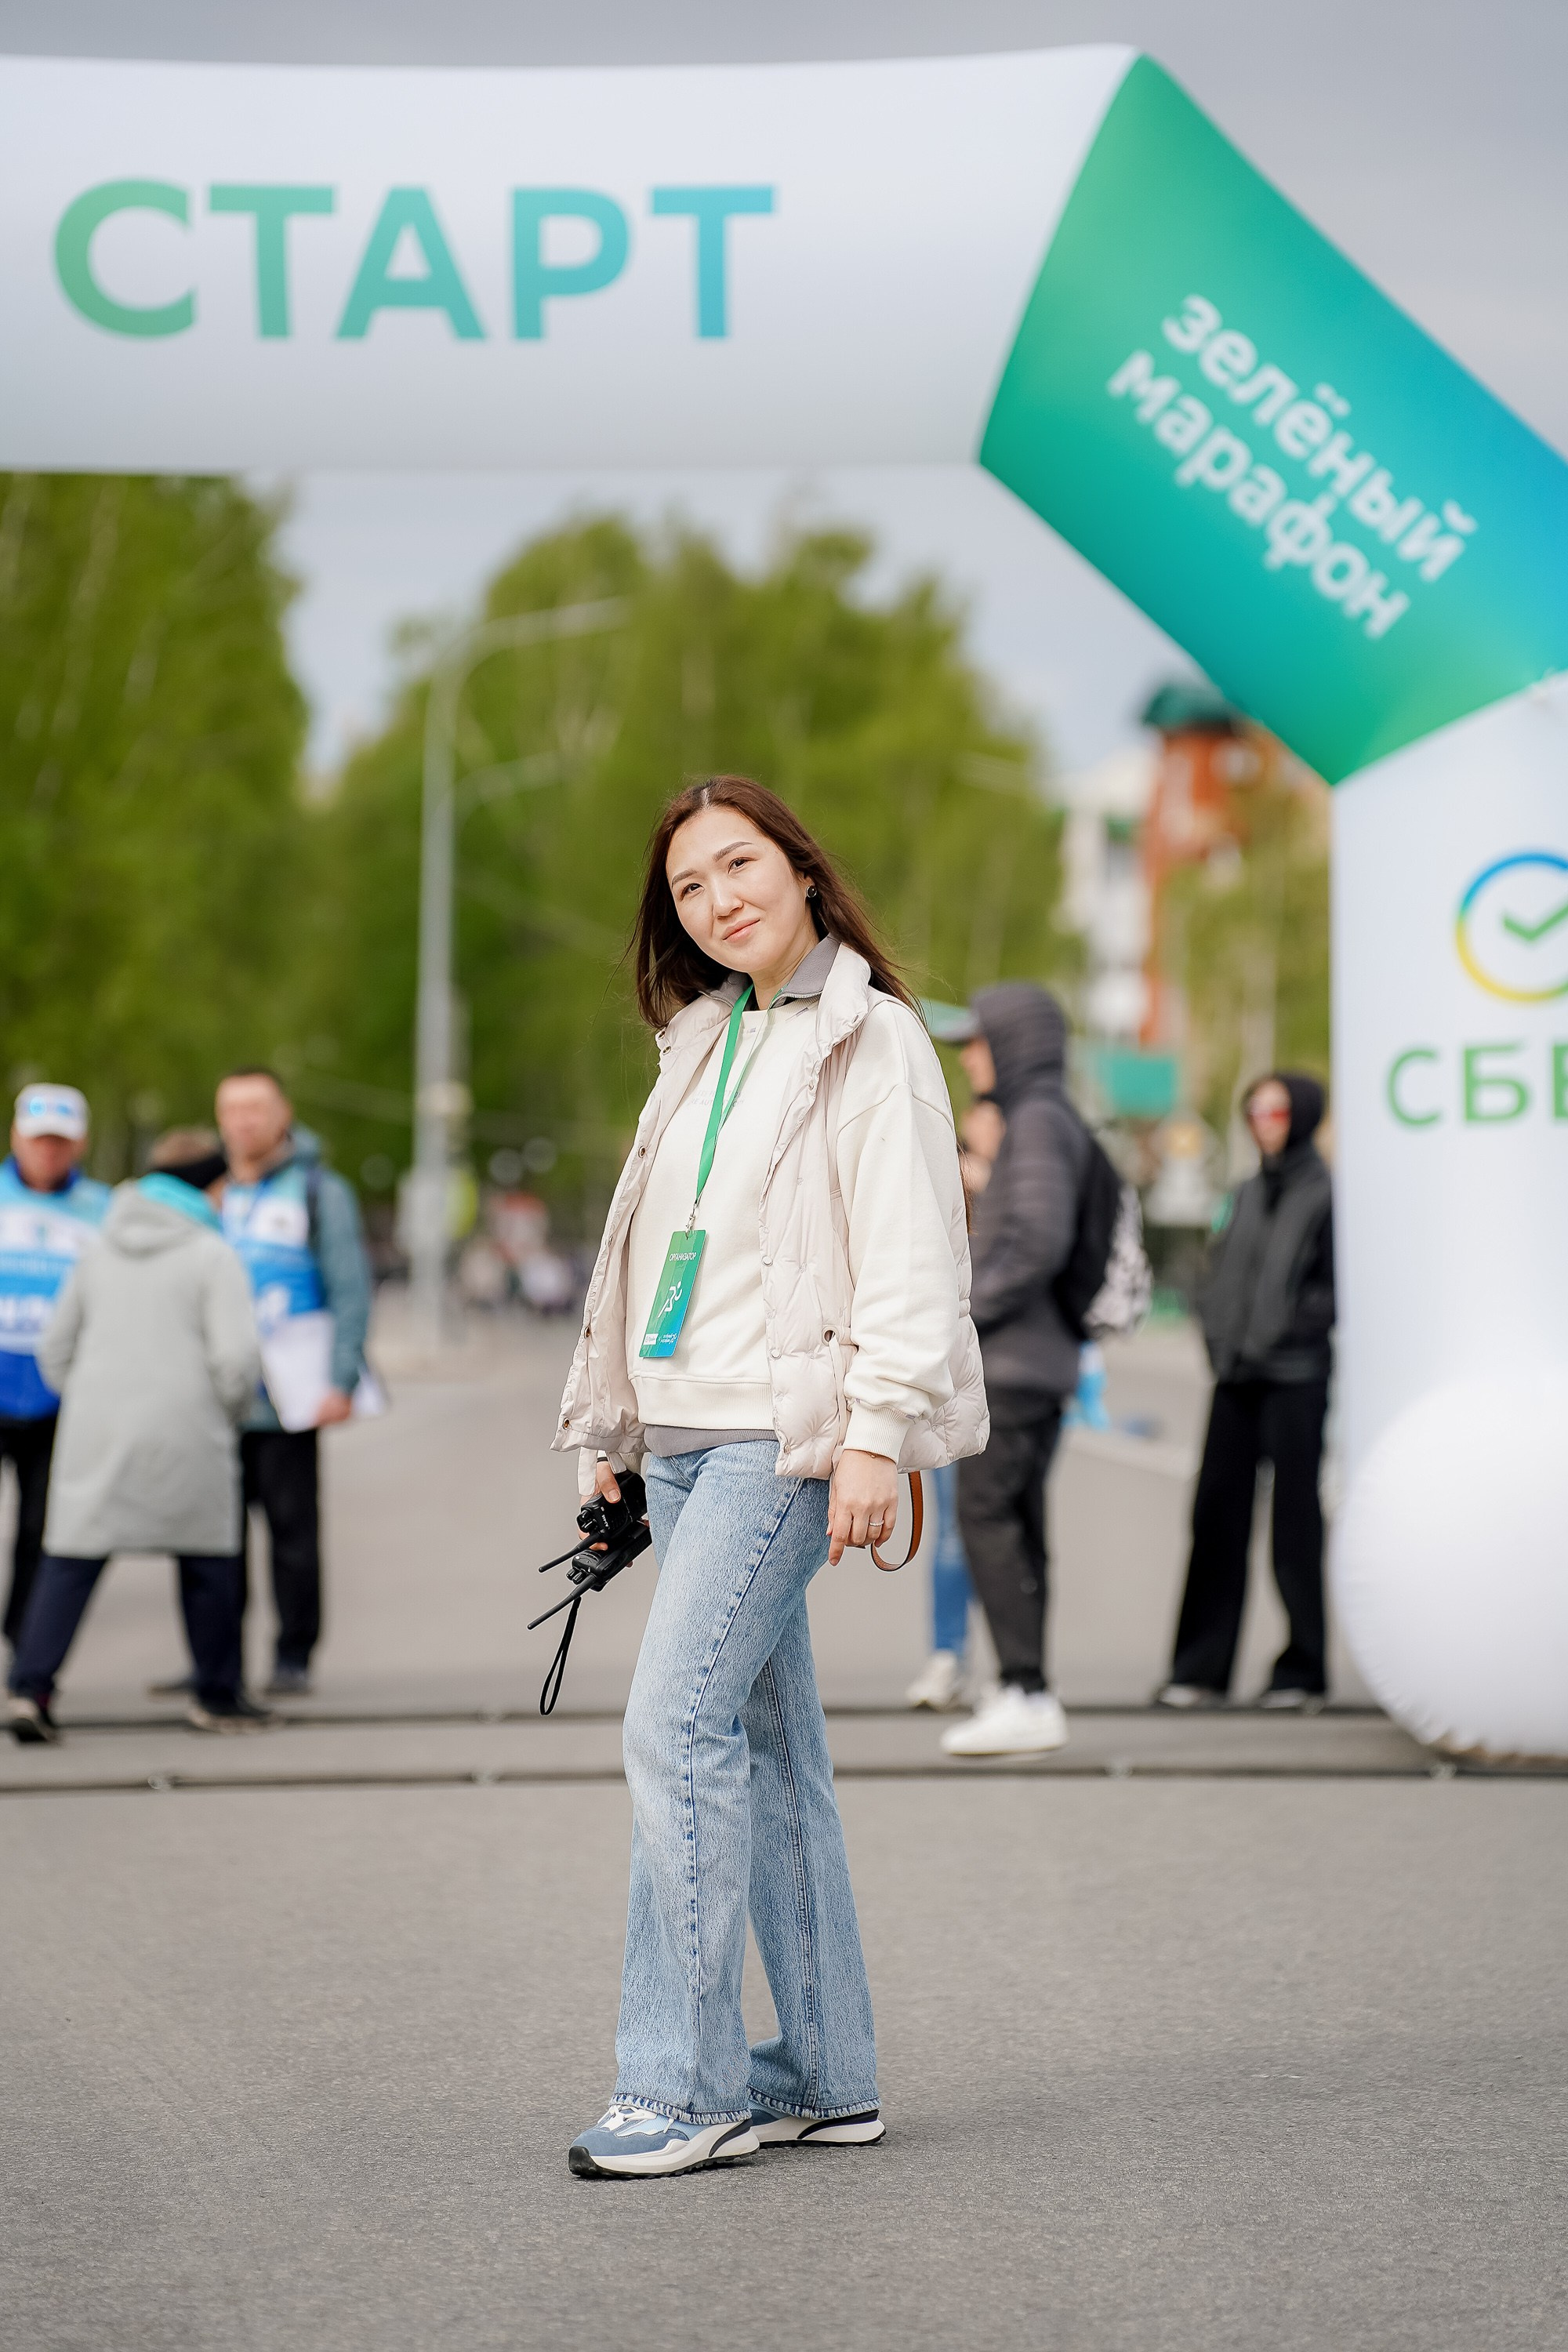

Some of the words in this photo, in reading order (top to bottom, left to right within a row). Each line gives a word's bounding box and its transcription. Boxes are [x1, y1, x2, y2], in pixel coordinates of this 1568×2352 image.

[53, 178, 776, 341] СТАРТ
[1107, 350, 1410, 640] марафон
[1160, 294, 1478, 583] зелёный
